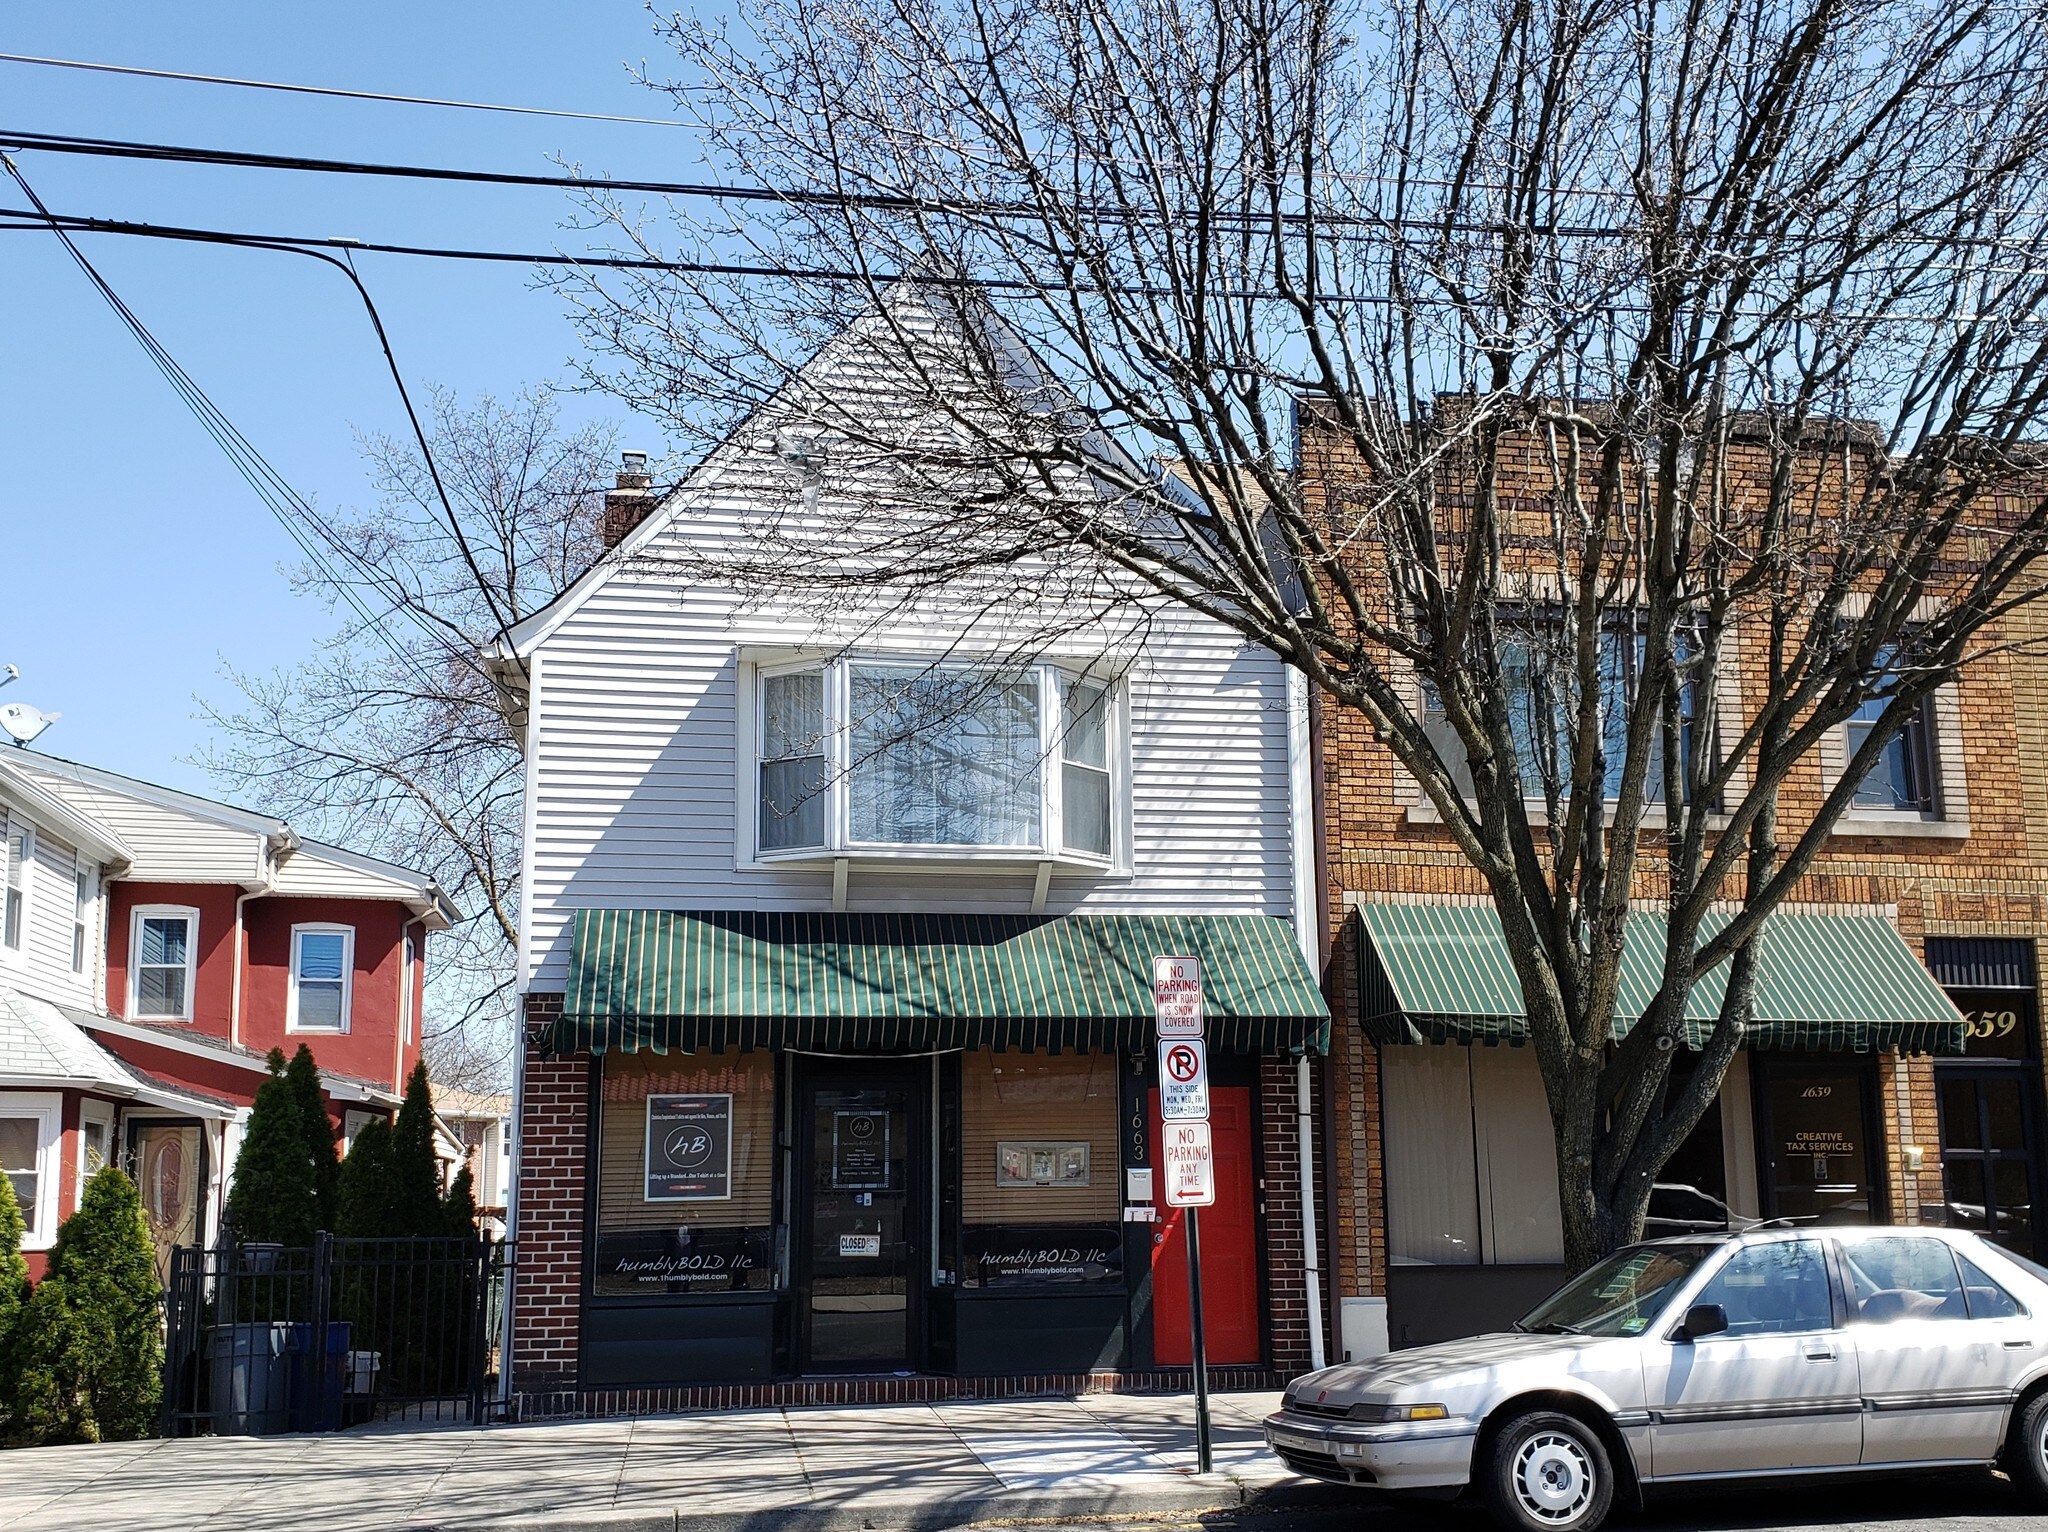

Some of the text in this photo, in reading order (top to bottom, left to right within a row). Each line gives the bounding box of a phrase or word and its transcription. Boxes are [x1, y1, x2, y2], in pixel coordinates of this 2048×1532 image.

[1170, 966, 1184, 978] NO
[1158, 979, 1198, 992] PARKING
[1158, 993, 1199, 1004] WHEN ROAD
[1164, 1005, 1194, 1016] IS SNOW
[1164, 1016, 1195, 1028] COVERED
[1964, 1010, 2017, 1038] 659
[1169, 1084, 1199, 1094] THIS SIDE
[1800, 1086, 1832, 1098] 1659
[1166, 1095, 1203, 1105] MON, WED, FRI
[1132, 1097, 1144, 1161] 1663
[1178, 1128, 1195, 1144] NO
[1795, 1132, 1843, 1141] CREATIVE
[1785, 1142, 1854, 1151] TAX SERVICES
[1167, 1145, 1208, 1162] PARKING
[1180, 1163, 1198, 1174] ANY
[1179, 1175, 1200, 1187] TIME
[841, 1237, 866, 1250] CLOSED
[979, 1248, 1081, 1269] humblyBOLD
[615, 1255, 725, 1276] humblyBOLD
[1000, 1266, 1084, 1276] www.1humblybold.com
[638, 1273, 728, 1283] www.1humblybold.com
